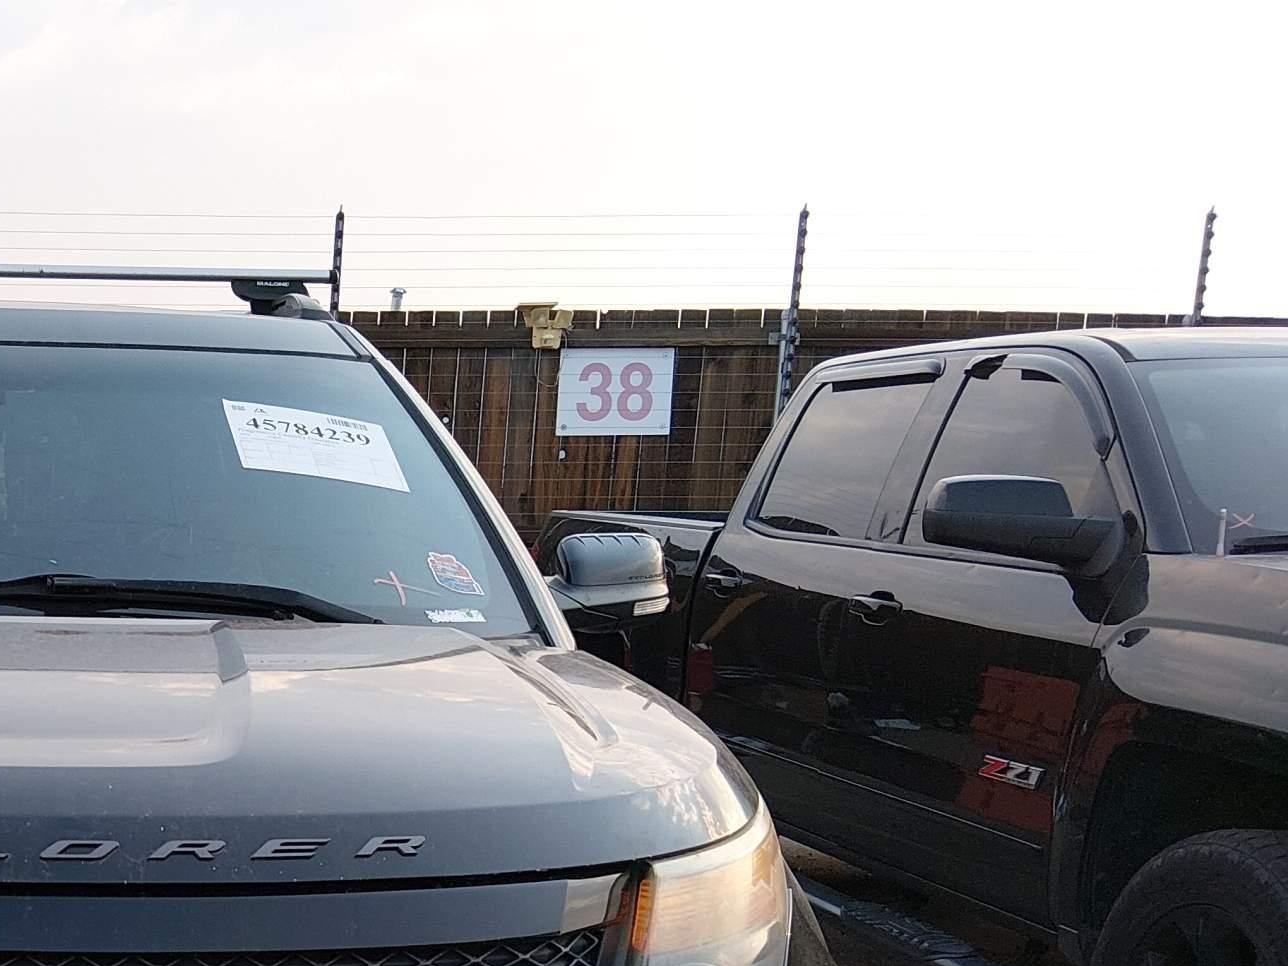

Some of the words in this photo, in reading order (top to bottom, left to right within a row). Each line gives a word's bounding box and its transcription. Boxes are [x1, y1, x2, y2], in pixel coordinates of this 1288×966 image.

[575, 362, 654, 422] 38
[245, 417, 371, 446] 45784239
[978, 754, 1046, 789] Z71
